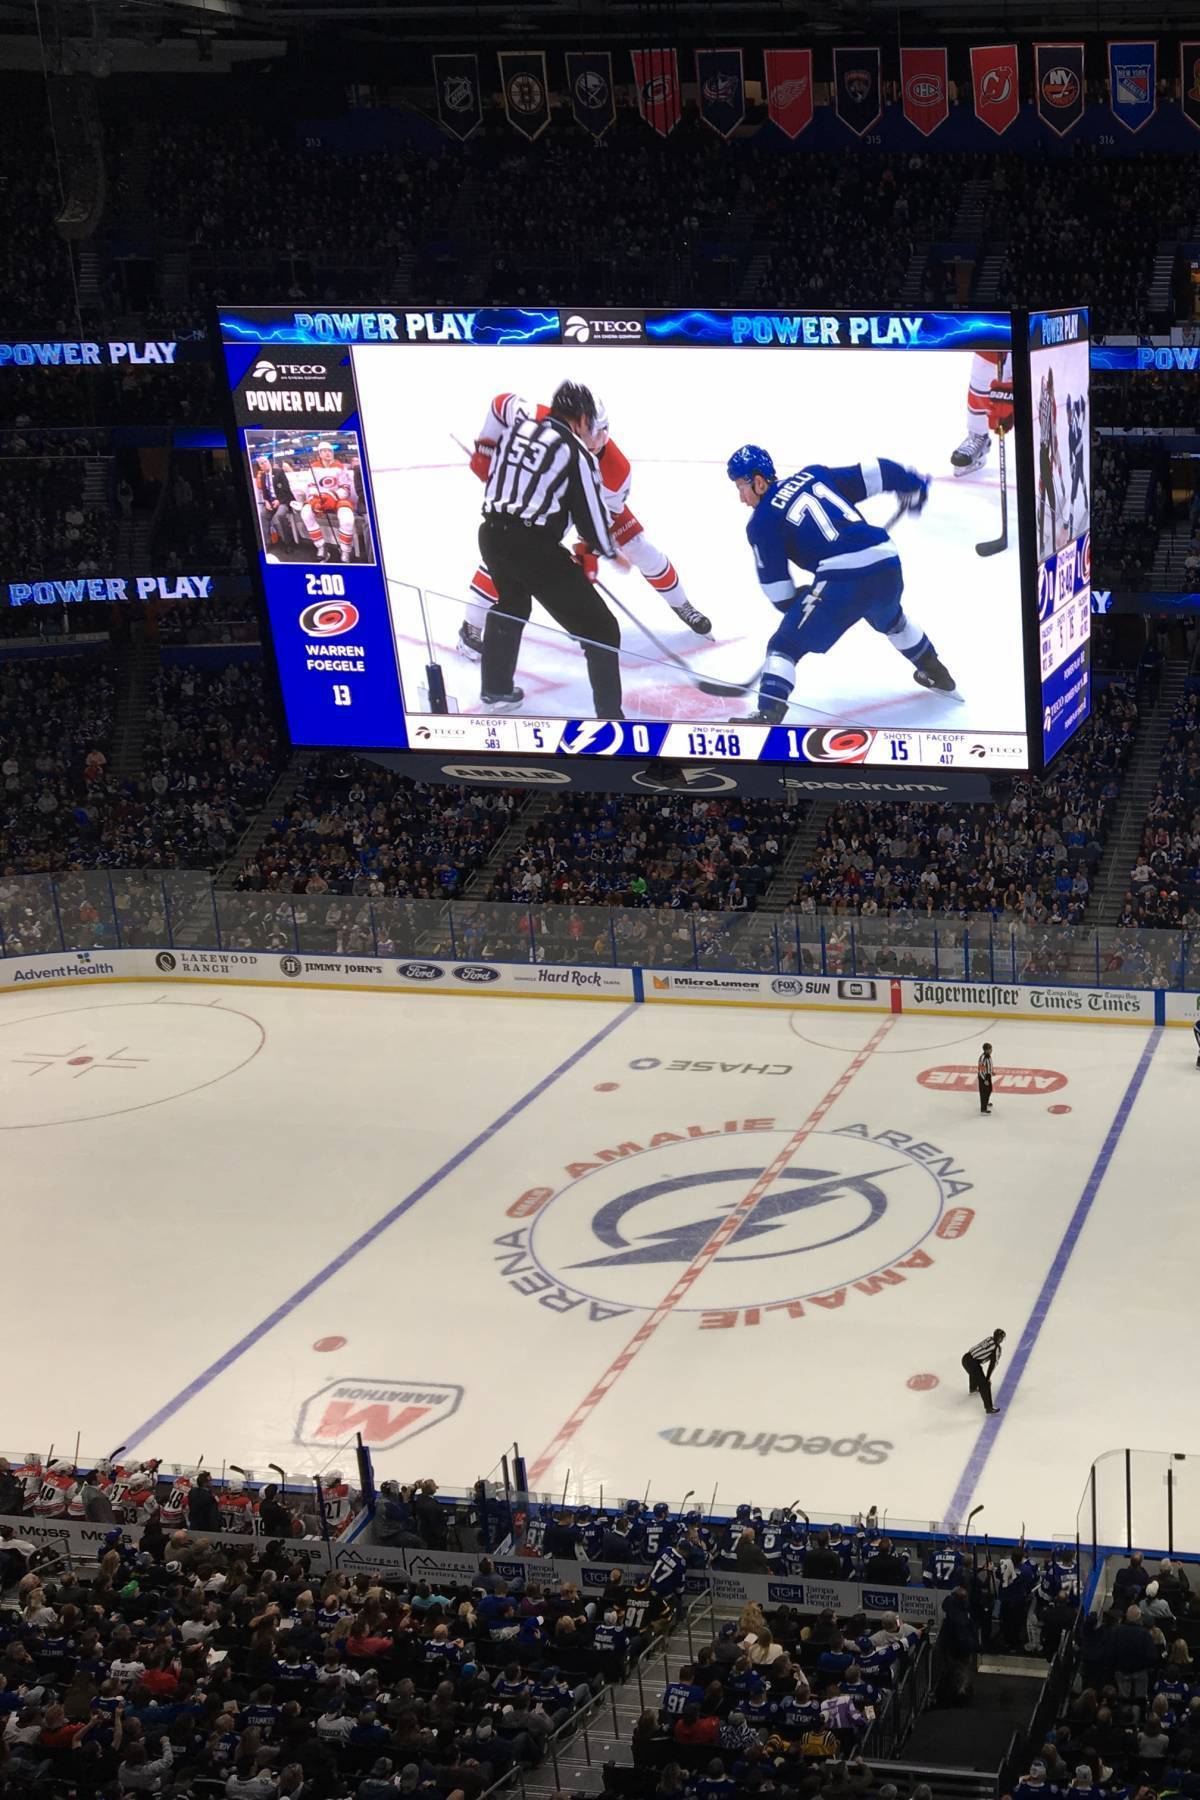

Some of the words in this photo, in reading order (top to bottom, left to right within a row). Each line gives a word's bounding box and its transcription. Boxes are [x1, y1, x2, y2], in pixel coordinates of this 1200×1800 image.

[1049, 70, 1072, 85] NY
[866, 135, 882, 145] 315
[1098, 135, 1115, 145] 316
[293, 313, 399, 340] POWER
[405, 313, 477, 340] PLAY
[589, 320, 642, 332] TECO
[732, 317, 841, 344] POWER
[849, 317, 924, 345] PLAY
[1041, 317, 1063, 345] POWER
[1064, 314, 1079, 342] PLAY
[0, 343, 102, 366] POWER
[108, 342, 177, 365] PLAY
[277, 364, 326, 375] TECO
[245, 390, 303, 411] POWER
[305, 391, 343, 412] PLAY
[508, 436, 547, 472] 53
[770, 471, 815, 510] CIRELLI
[785, 481, 861, 542] 71
[9, 578, 128, 606] POWER
[136, 576, 211, 599] PLAY
[305, 574, 345, 595] 2:00
[305, 645, 364, 657] WARREN
[306, 660, 365, 672] FOEGELE
[333, 685, 351, 706] 13
[523, 720, 550, 728] SHOTS
[533, 728, 544, 748] 5
[632, 725, 650, 753] 0
[688, 733, 740, 756] 13:48
[787, 730, 800, 758] 1
[883, 733, 912, 741] SHOTS
[926, 734, 965, 742] FACEOFF
[890, 740, 908, 761] 15
[942, 742, 952, 753] 10
[453, 768, 561, 781] AMALIE
[778, 778, 937, 793] Spectrum
[181, 953, 258, 965] LAKEWOOD
[182, 963, 230, 973] RANCH
[304, 963, 342, 974] JIMMY
[344, 964, 383, 975] JOHN'S
[405, 964, 437, 979] Ford
[460, 967, 492, 982] Ford
[538, 969, 570, 983] Hard
[571, 970, 602, 987] Rock
[674, 977, 760, 989] MicroLumen
[777, 980, 796, 990] FOX
[805, 982, 831, 995] SUN
[1029, 990, 1083, 1009] Times
[1088, 993, 1141, 1012] Times
[665, 1059, 793, 1076] CHASE
[564, 1118, 775, 1179] AMALIE
[831, 1122, 975, 1199] ARENA
[494, 1227, 634, 1322] ARENA
[699, 1248, 935, 1330] AMALIE
[332, 1388, 449, 1405] MARATHON
[669, 1427, 895, 1465] Spectrum
[326, 1501, 341, 1519] 27
[647, 1534, 660, 1553] 5
[650, 1559, 674, 1584] 17
[935, 1561, 954, 1581] 17
[712, 1578, 740, 1586] Tampa
[712, 1585, 745, 1593] General
[806, 1586, 834, 1595] Tampa
[773, 1587, 802, 1598] TGH
[806, 1593, 839, 1602] General
[870, 1594, 898, 1607] TGH
[901, 1593, 929, 1603] Tampa
[901, 1600, 933, 1609] General
[625, 1607, 647, 1628] 91
[667, 1694, 686, 1714] 91
